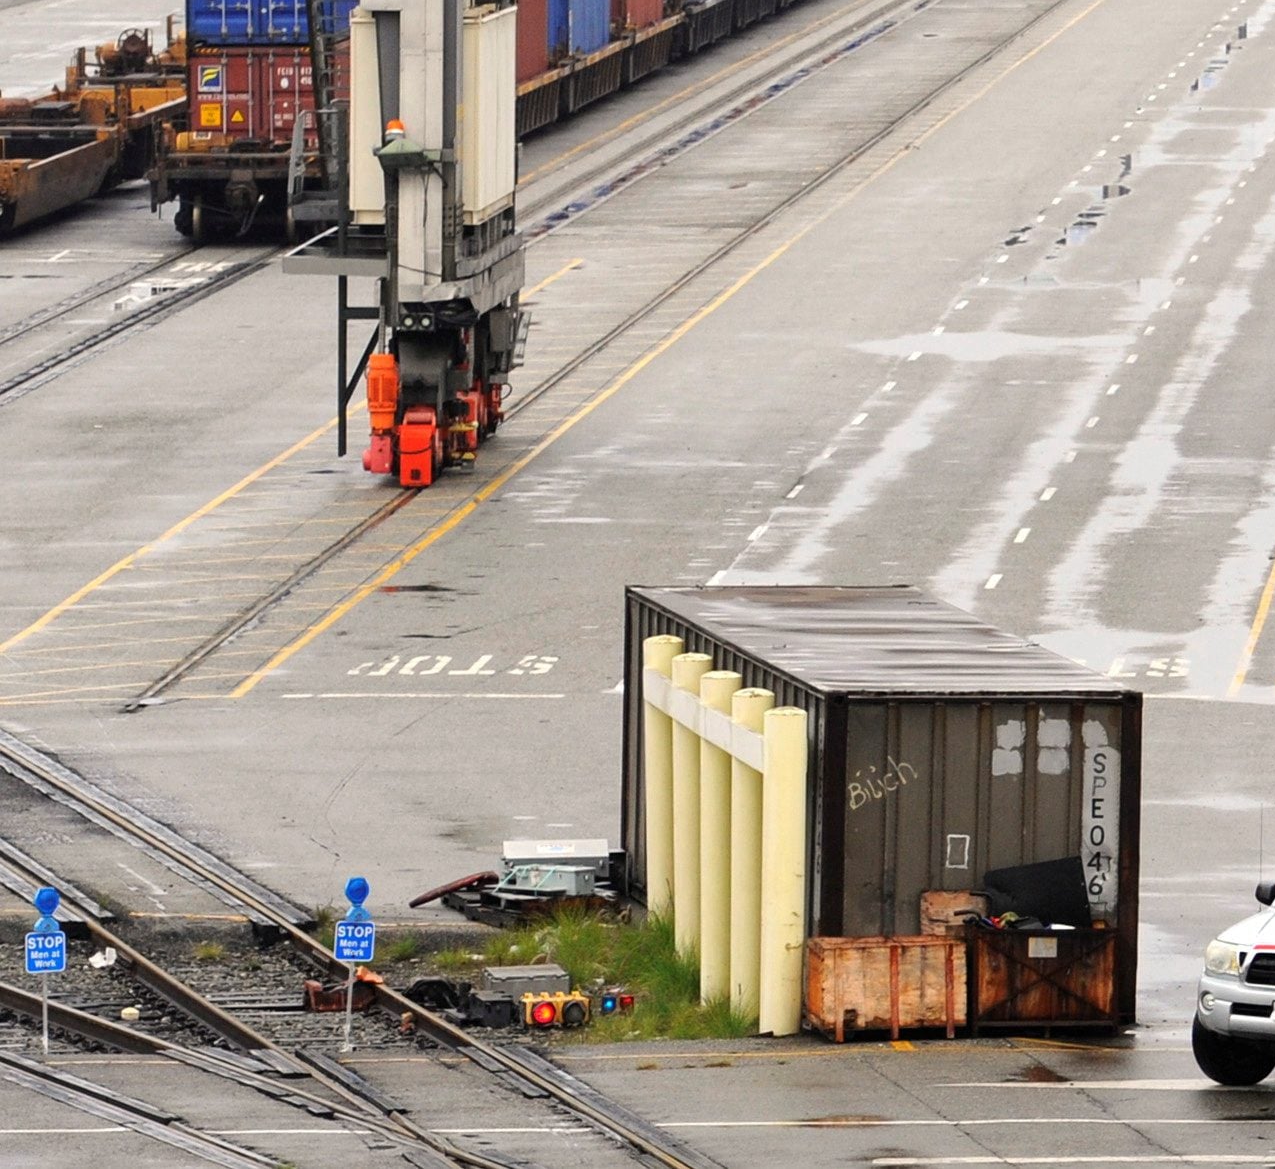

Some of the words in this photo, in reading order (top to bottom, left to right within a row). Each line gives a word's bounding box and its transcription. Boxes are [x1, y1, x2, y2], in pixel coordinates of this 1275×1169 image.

[337, 924, 373, 938] STOP
[28, 935, 63, 950] STOP
[339, 938, 358, 948] Men
[360, 939, 369, 948] at
[30, 949, 49, 960] Men
[51, 948, 60, 959] at
[342, 948, 365, 957] Work
[34, 960, 56, 969] Work
